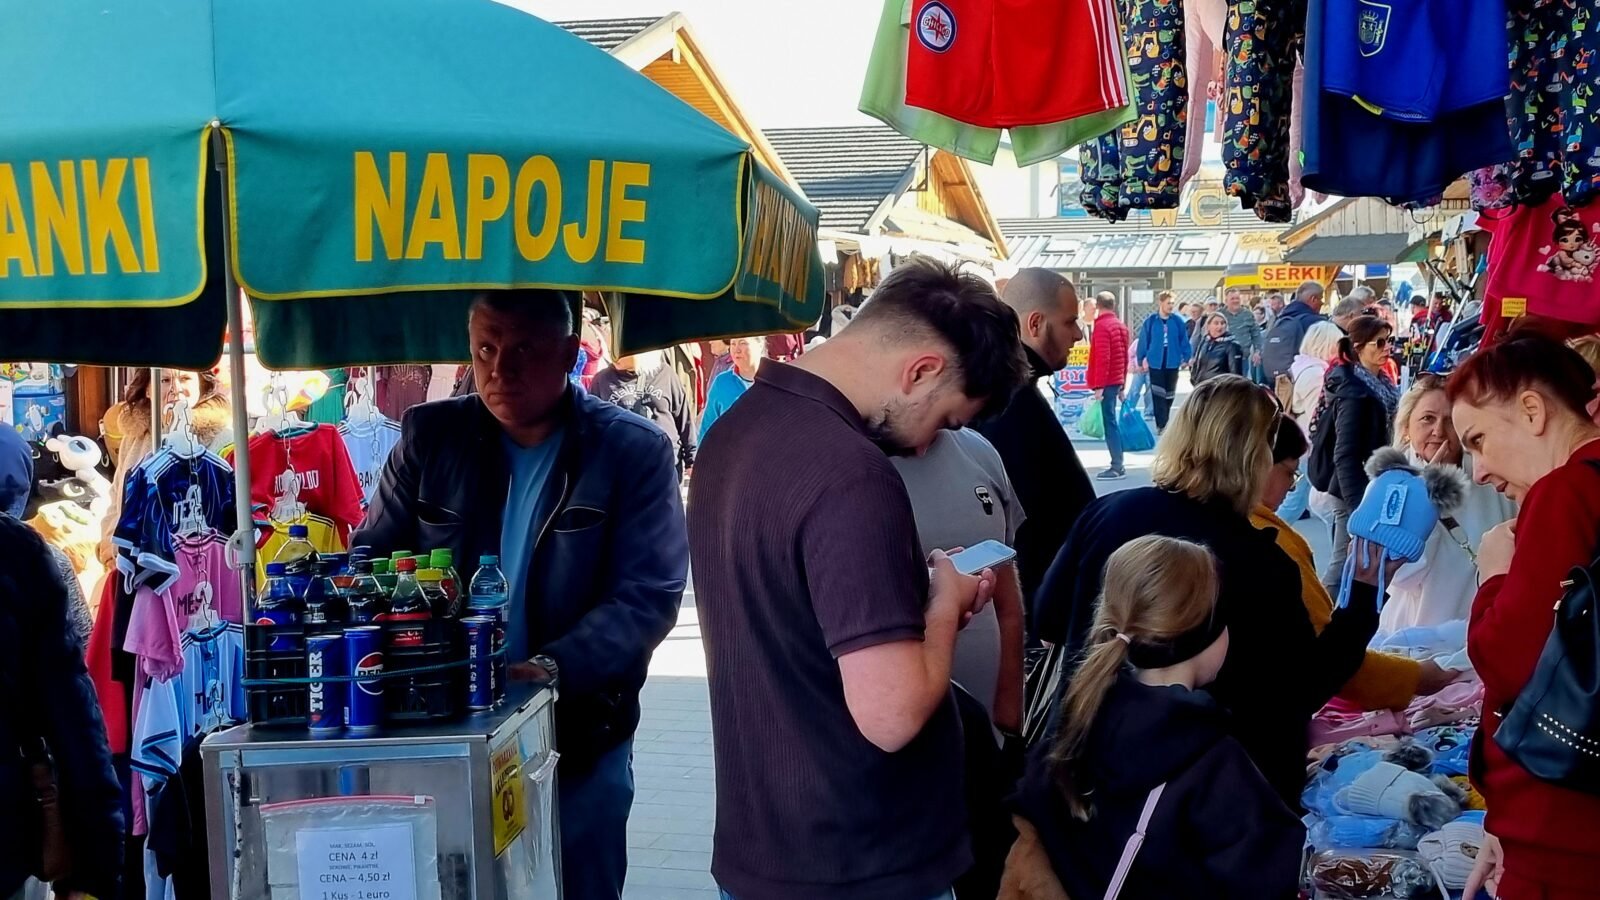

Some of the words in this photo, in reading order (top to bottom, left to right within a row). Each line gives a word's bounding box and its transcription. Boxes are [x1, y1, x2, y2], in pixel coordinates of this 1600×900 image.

[354, 151, 651, 264] NAPOJE
[1263, 267, 1320, 280] SERKI
[308, 650, 324, 713] TIGER
[328, 852, 356, 862] CENA
[361, 852, 368, 861] 4
[319, 874, 346, 883] CENA
[357, 872, 380, 884] 4,50
[382, 872, 391, 881] zł
[322, 891, 328, 900] 1
[331, 891, 349, 900] Kus
[358, 890, 364, 900] 1
[366, 891, 391, 900] euro
